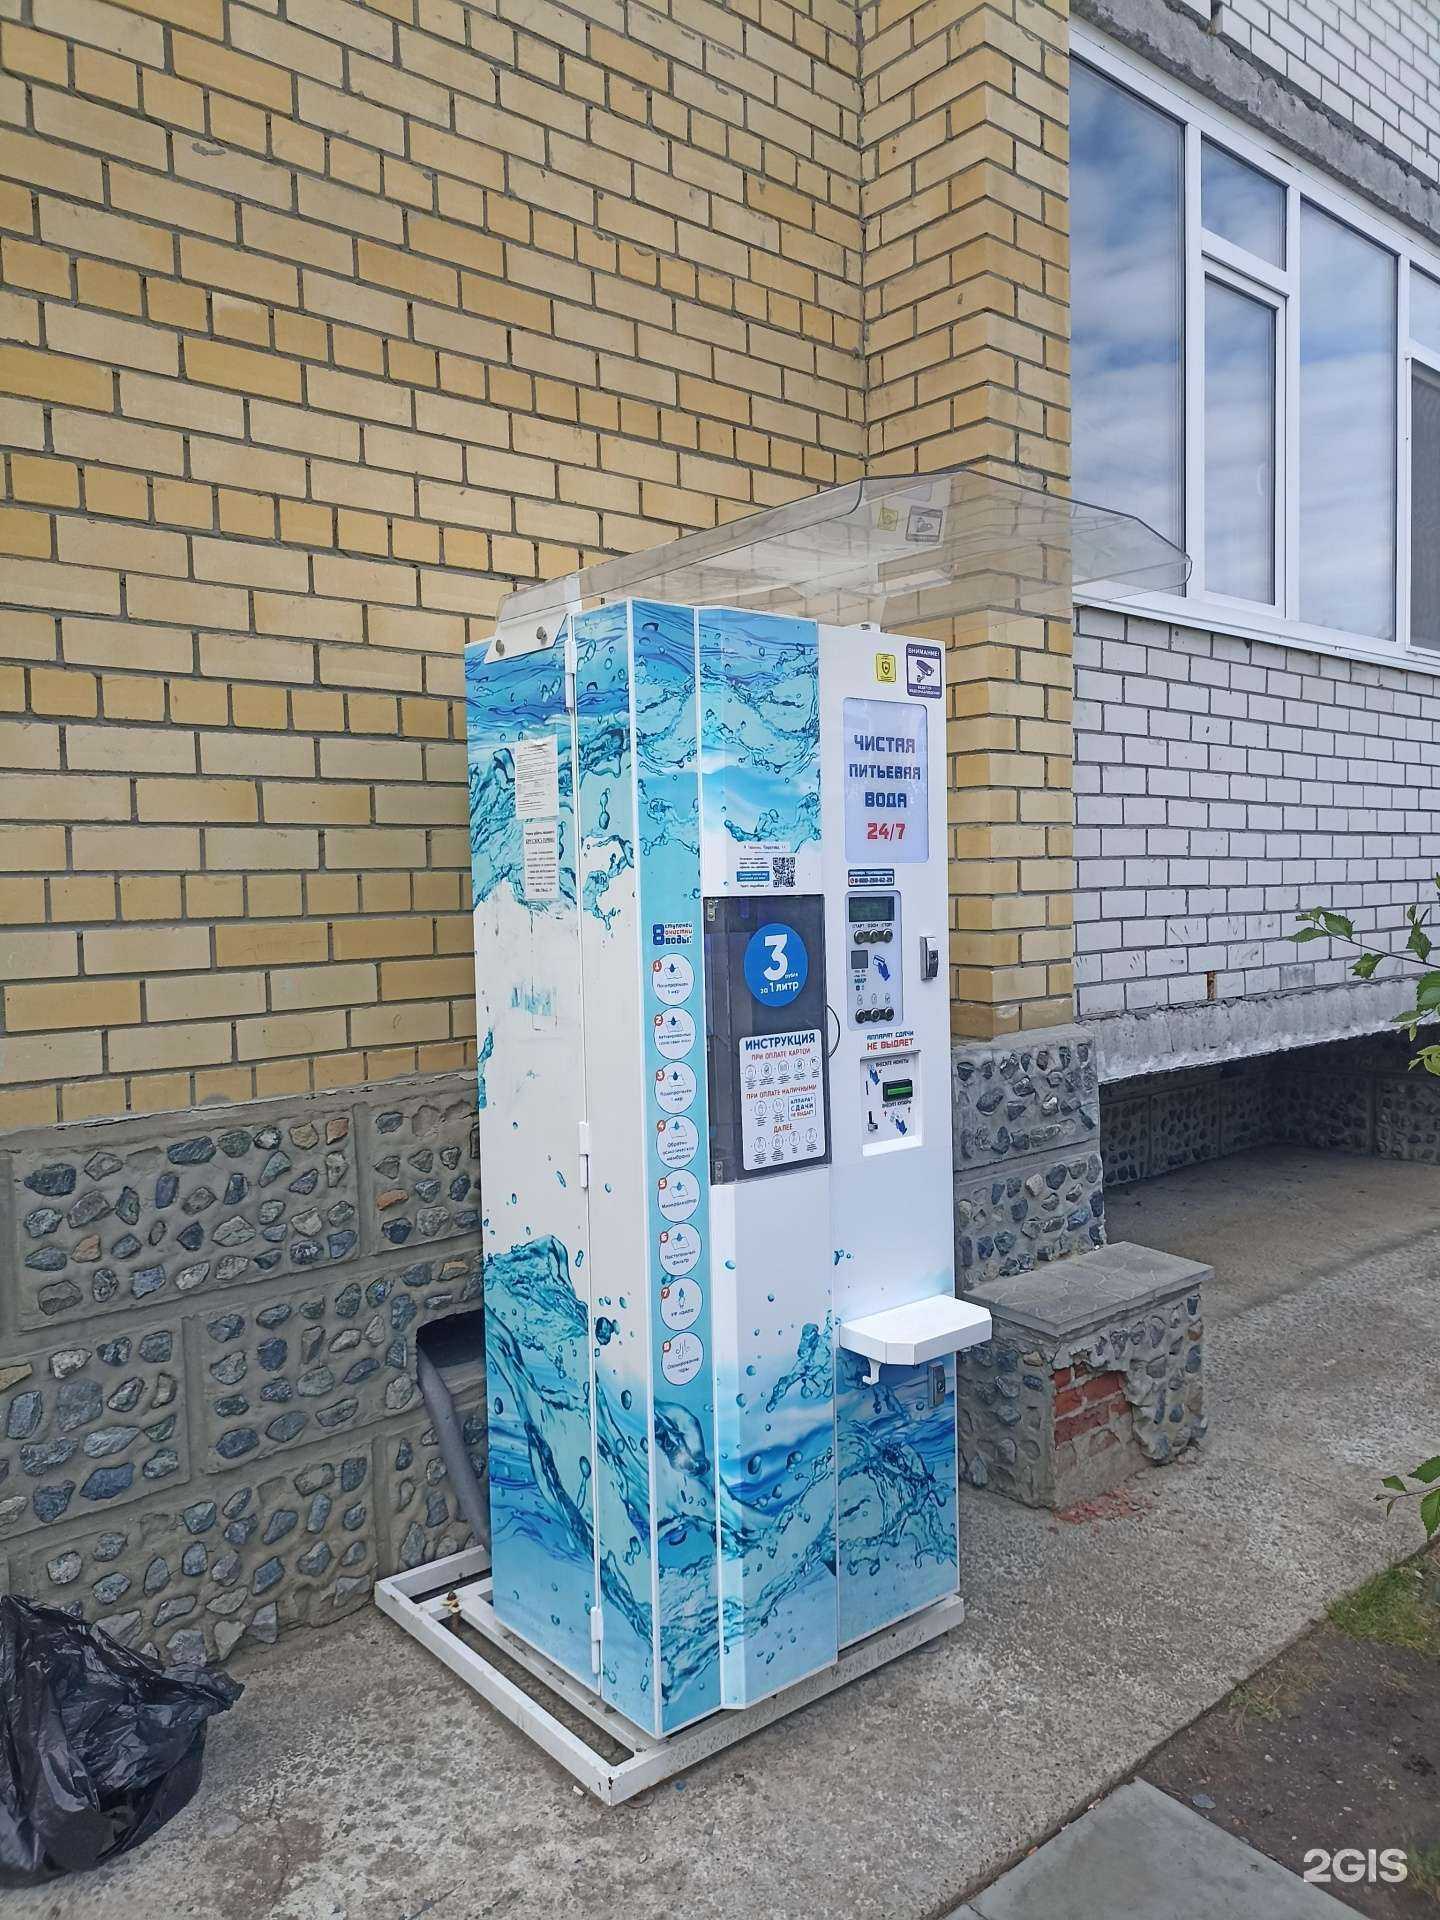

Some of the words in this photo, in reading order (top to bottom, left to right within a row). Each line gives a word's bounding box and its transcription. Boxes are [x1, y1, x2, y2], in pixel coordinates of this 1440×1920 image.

[853, 734, 916, 753] ЧИСТАЯ
[848, 763, 921, 780] ПИТЬЕВАЯ
[864, 791, 907, 808] ВОДА
[867, 822, 906, 841] 24/7
[652, 923, 665, 946] 8
[763, 933, 788, 981] 3
[769, 982, 774, 993] 1
[776, 981, 799, 992] литр
[745, 1032, 816, 1051] ИНСТРУКЦИЯ
[867, 1042, 878, 1051] НЕ
[881, 1038, 914, 1049] ВЫДАЕТ
[751, 1053, 764, 1061] ПРИ
[764, 1050, 787, 1060] ОПЛАТЕ
